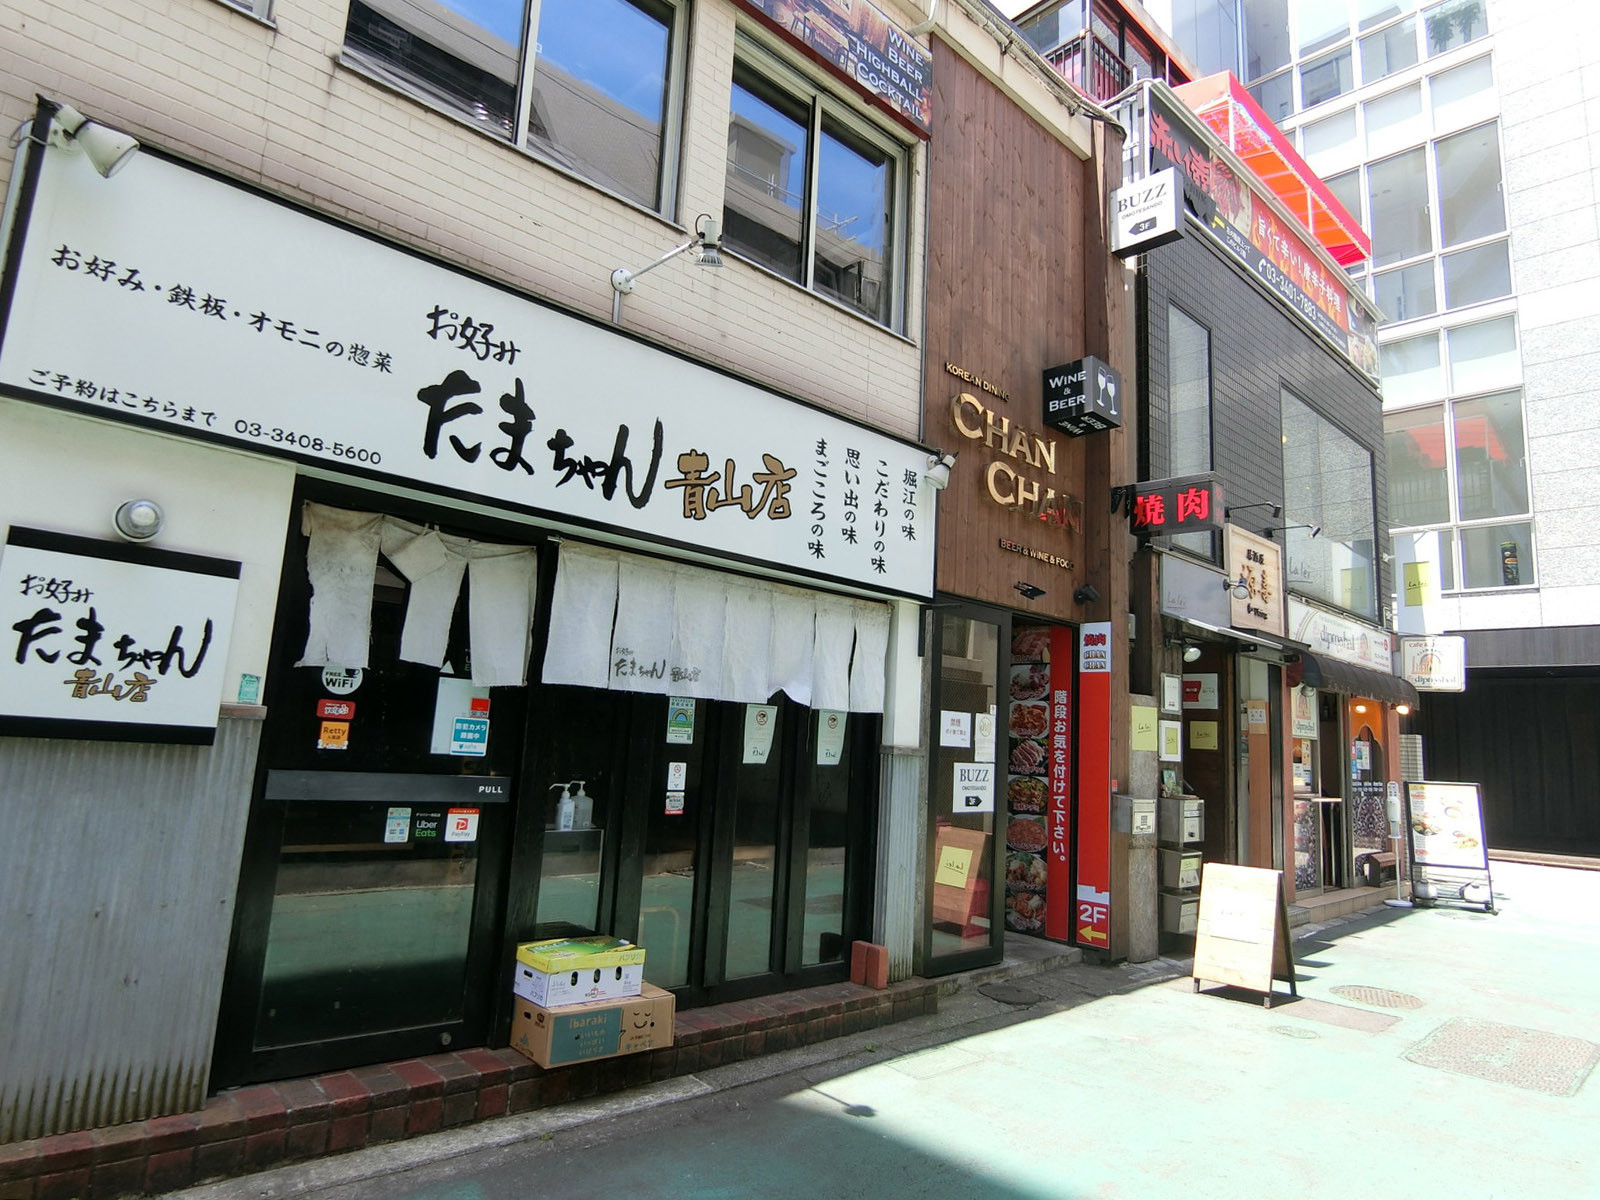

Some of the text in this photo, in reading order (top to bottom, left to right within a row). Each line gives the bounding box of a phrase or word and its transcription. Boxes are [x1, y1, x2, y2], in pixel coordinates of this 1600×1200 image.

[888, 28, 924, 66] WINE
[888, 47, 923, 84] BEER
[856, 41, 923, 102] HIGHBALL
[857, 62, 923, 120] COCKTAIL
[1117, 182, 1167, 213] BUZZ
[1140, 221, 1151, 231] 3F
[426, 305, 520, 364] お好み
[946, 362, 1009, 402] KOREAN DINING
[1050, 370, 1087, 389] WINE
[1064, 387, 1071, 395] &
[28, 367, 381, 465] ご予約はこちらまで 03-3408-5600
[1049, 395, 1086, 412] BEER
[416, 369, 797, 520] たまちゃん 青山店
[953, 392, 1057, 475] CHAN
[808, 439, 826, 559] まごころの味
[840, 447, 861, 545] 思い出の味
[901, 468, 917, 542] 堀江の味
[986, 461, 1083, 535] CHAN
[1133, 488, 1210, 527] 焼肉
[871, 459, 888, 574] こだわりの味
[1000, 538, 1023, 554] BEER
[1023, 546, 1029, 556] &
[1030, 547, 1049, 562] WINE
[1049, 555, 1055, 564] &
[20, 574, 94, 603] お好み
[12, 607, 213, 678] たまちゃん
[64, 668, 157, 702] 青山店
[325, 677, 353, 688] WiFi
[615, 657, 666, 679] たまちゃん
[323, 727, 347, 736] Retty
[960, 768, 989, 782] BUZZ
[1052, 690, 1067, 862] 階段お気を付けて下さい。
[415, 829, 436, 837] Eats
[416, 820, 437, 829] Uber
[1079, 904, 1107, 923] 2F
